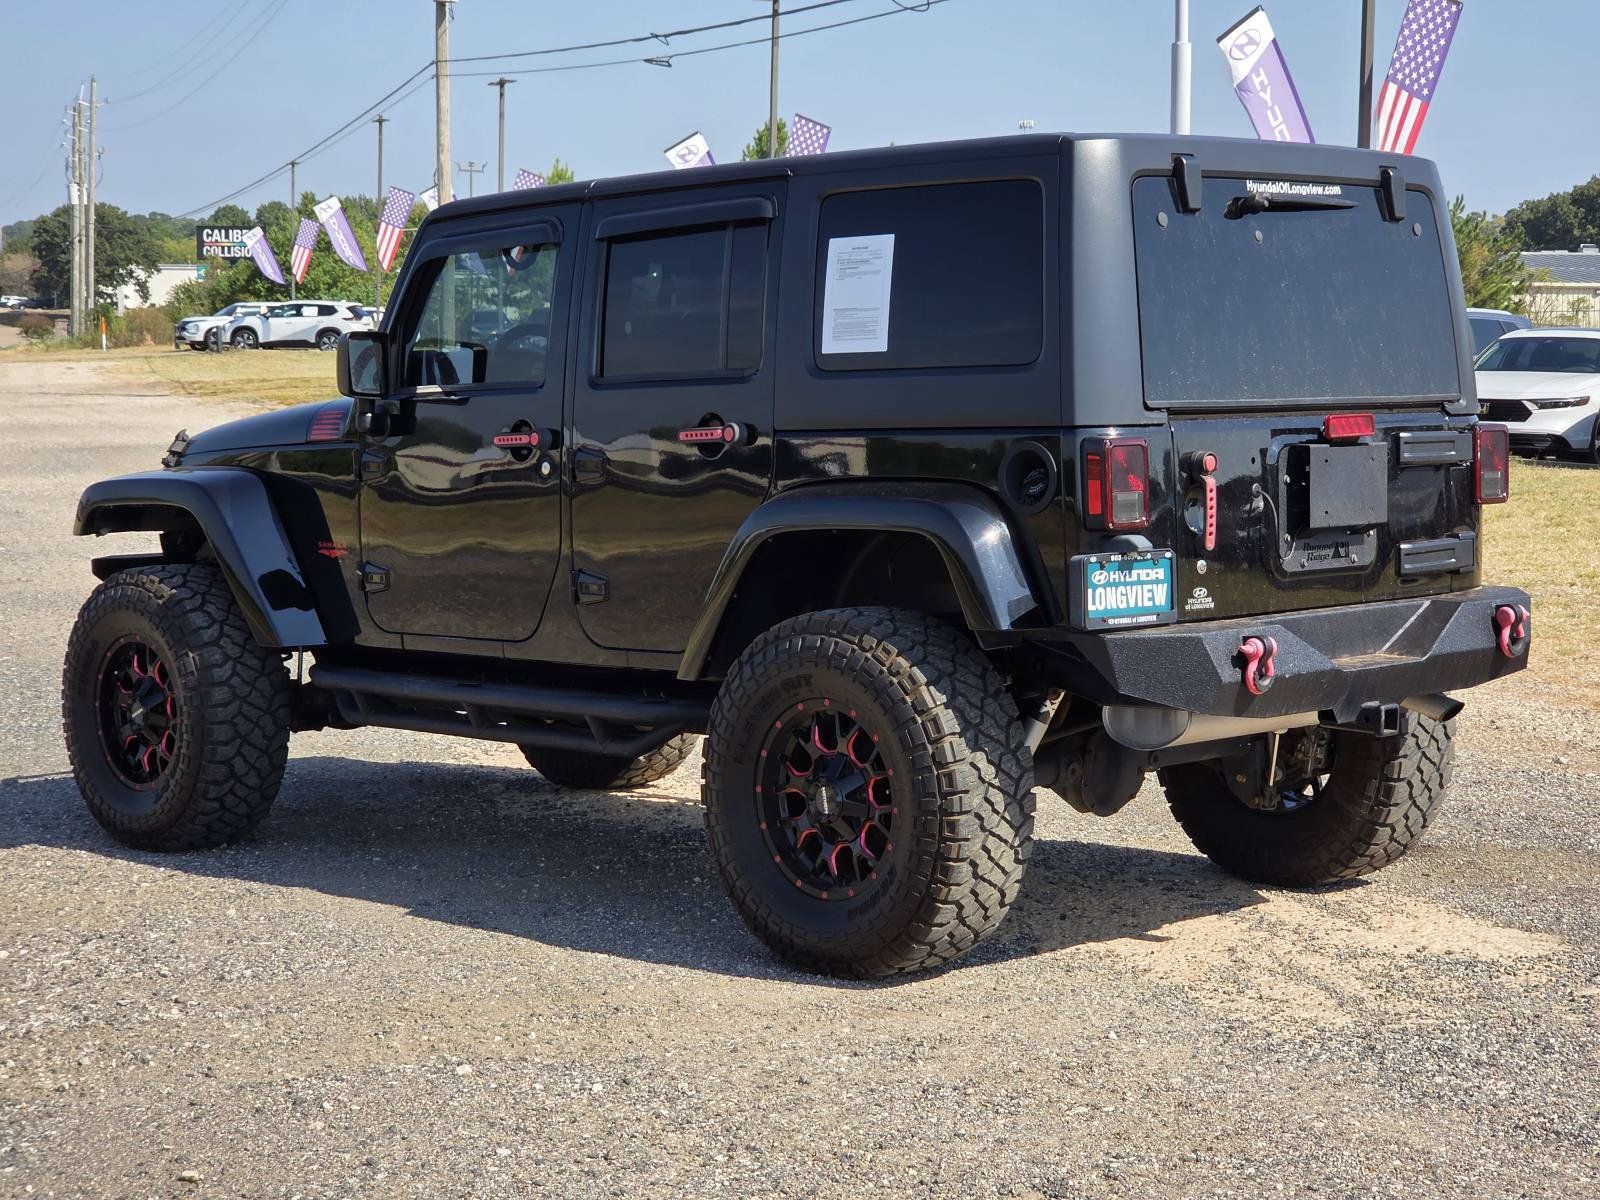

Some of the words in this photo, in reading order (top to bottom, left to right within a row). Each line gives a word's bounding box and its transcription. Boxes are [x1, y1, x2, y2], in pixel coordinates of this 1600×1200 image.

[1246, 180, 1342, 195] HyundaiOfLongview.com
[1109, 568, 1165, 582] HYUNDAI
[1088, 583, 1168, 611] LONGVIEW
